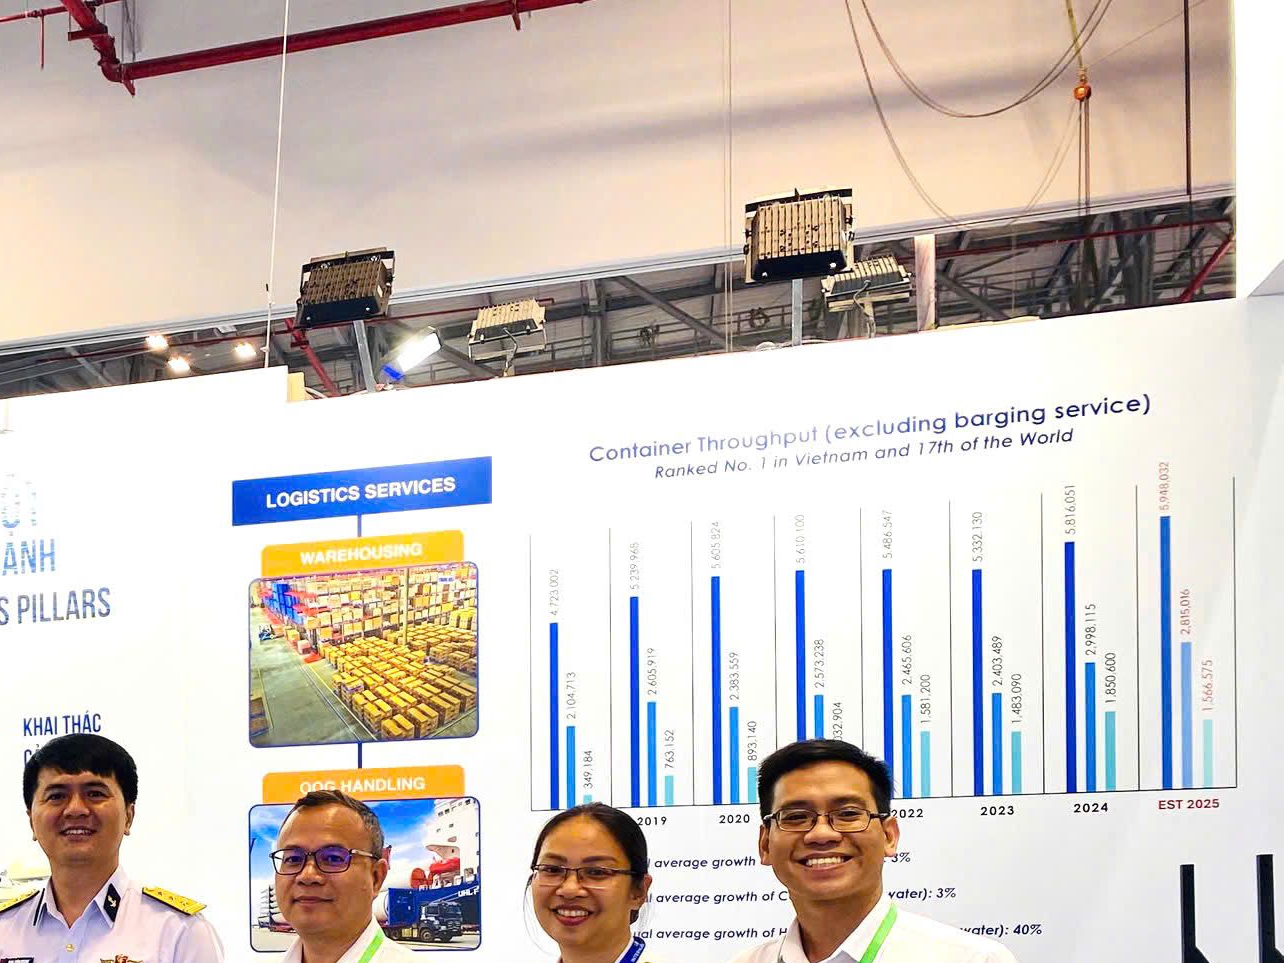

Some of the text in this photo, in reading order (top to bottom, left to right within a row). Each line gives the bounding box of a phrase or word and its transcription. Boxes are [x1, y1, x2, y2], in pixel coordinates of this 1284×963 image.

[589, 394, 1151, 462] Container Throughput (excluding barging service)
[655, 428, 1074, 479] Ranked No. 1 in Vietnam and 17th of the World
[266, 477, 456, 509] LOGISTICS SERVICES
[300, 542, 423, 565] WAREHOUSING
[17, 587, 111, 625] PILLARS
[23, 710, 101, 736] KHAI THÁC
[341, 777, 426, 793] HANDLING
[980, 805, 1014, 816] 2023
[1073, 803, 1109, 813] 2024
[1158, 799, 1220, 810] EST 2025
[719, 814, 750, 824] 2020
[891, 809, 924, 818] 2022
[637, 817, 667, 826] 2019
[654, 859, 708, 870] average
[712, 856, 756, 869] growth
[656, 894, 710, 905] average
[713, 891, 757, 905] growth
[762, 891, 775, 901] of
[936, 887, 956, 899] 3%
[656, 930, 710, 941] average
[714, 928, 758, 941] growth
[762, 928, 775, 938] of
[1013, 924, 1043, 936] 40%
